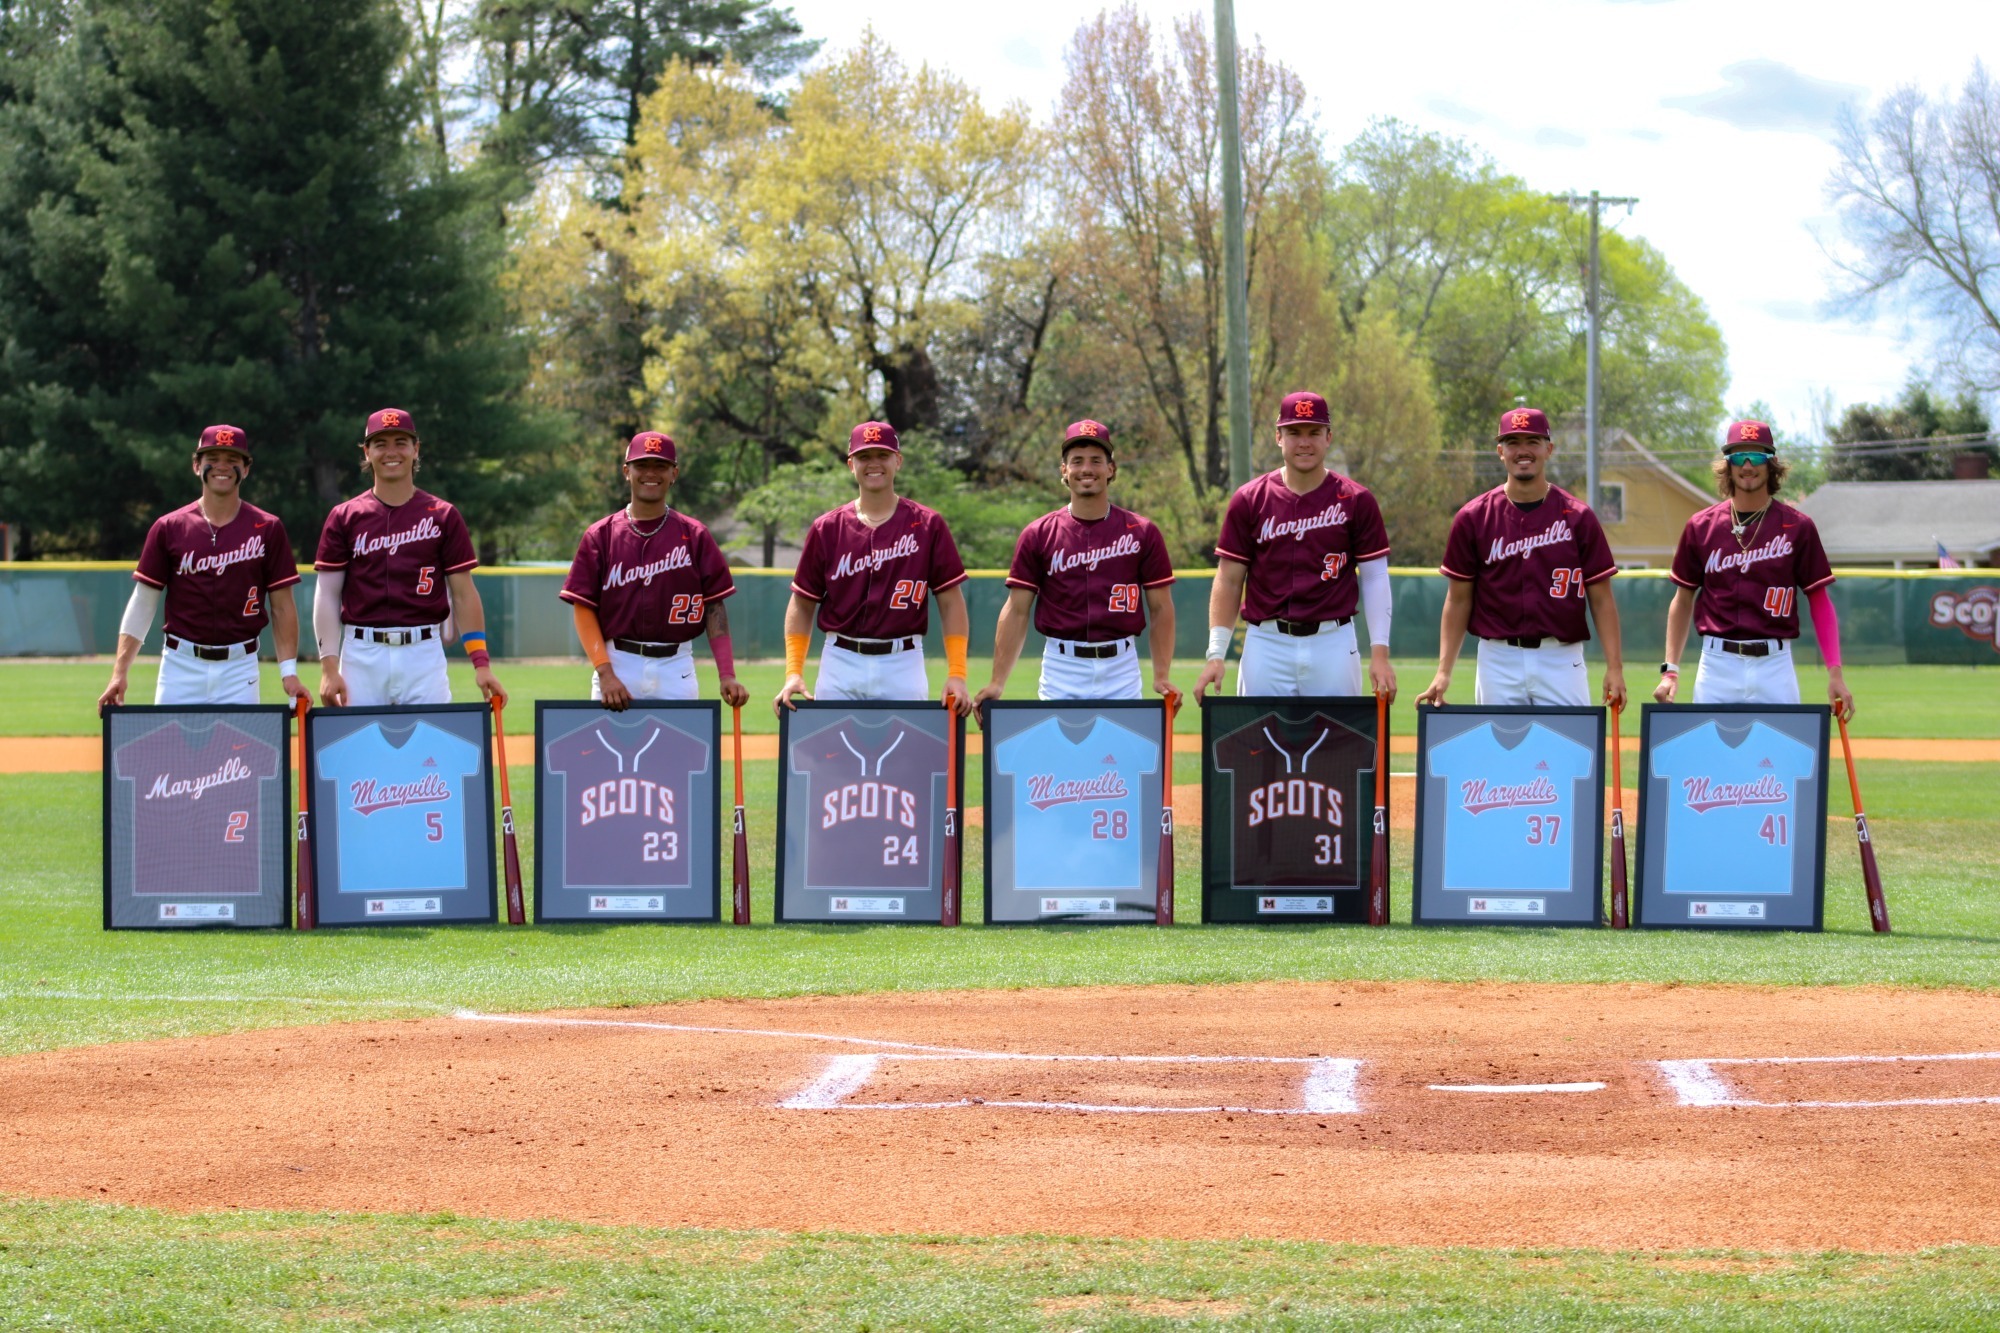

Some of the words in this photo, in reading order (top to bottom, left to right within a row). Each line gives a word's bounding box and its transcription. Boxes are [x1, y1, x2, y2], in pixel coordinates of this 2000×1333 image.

[352, 516, 442, 558] Maryville
[1256, 502, 1348, 544] Maryville
[176, 534, 265, 576] Maryville
[830, 533, 920, 581] Maryville
[1047, 533, 1141, 576] Maryville
[1484, 520, 1572, 566] Maryville
[1704, 533, 1793, 574] Maryville
[416, 566, 436, 596] 5
[602, 544, 692, 591] Maryville
[1549, 567, 1586, 599] 37
[668, 593, 704, 624] 23
[890, 579, 928, 610] 24
[1108, 582, 1140, 614] 28
[1763, 586, 1794, 618] 41
[144, 756, 252, 800] Maryville
[350, 773, 451, 810] Maryville
[1026, 770, 1128, 805] Maryville
[1460, 776, 1558, 809] Maryville
[1682, 774, 1788, 807] Maryville
[580, 778, 675, 826] SCOTS
[822, 782, 916, 830] SCOTS
[1248, 779, 1343, 828] SCOTS
[224, 811, 249, 842] 2
[425, 811, 444, 843] 5
[1091, 808, 1129, 840] 28
[1526, 814, 1562, 846] 37
[1758, 813, 1788, 846] 41
[642, 831, 678, 862] 23
[883, 834, 918, 866] 24
[1314, 834, 1343, 866] 31
[164, 906, 177, 916] M
[371, 902, 384, 912] M
[594, 898, 607, 908] M
[836, 898, 848, 910] M
[1046, 900, 1058, 910] M
[1263, 898, 1275, 909] M
[1474, 900, 1486, 910] M
[1694, 904, 1707, 914] M
